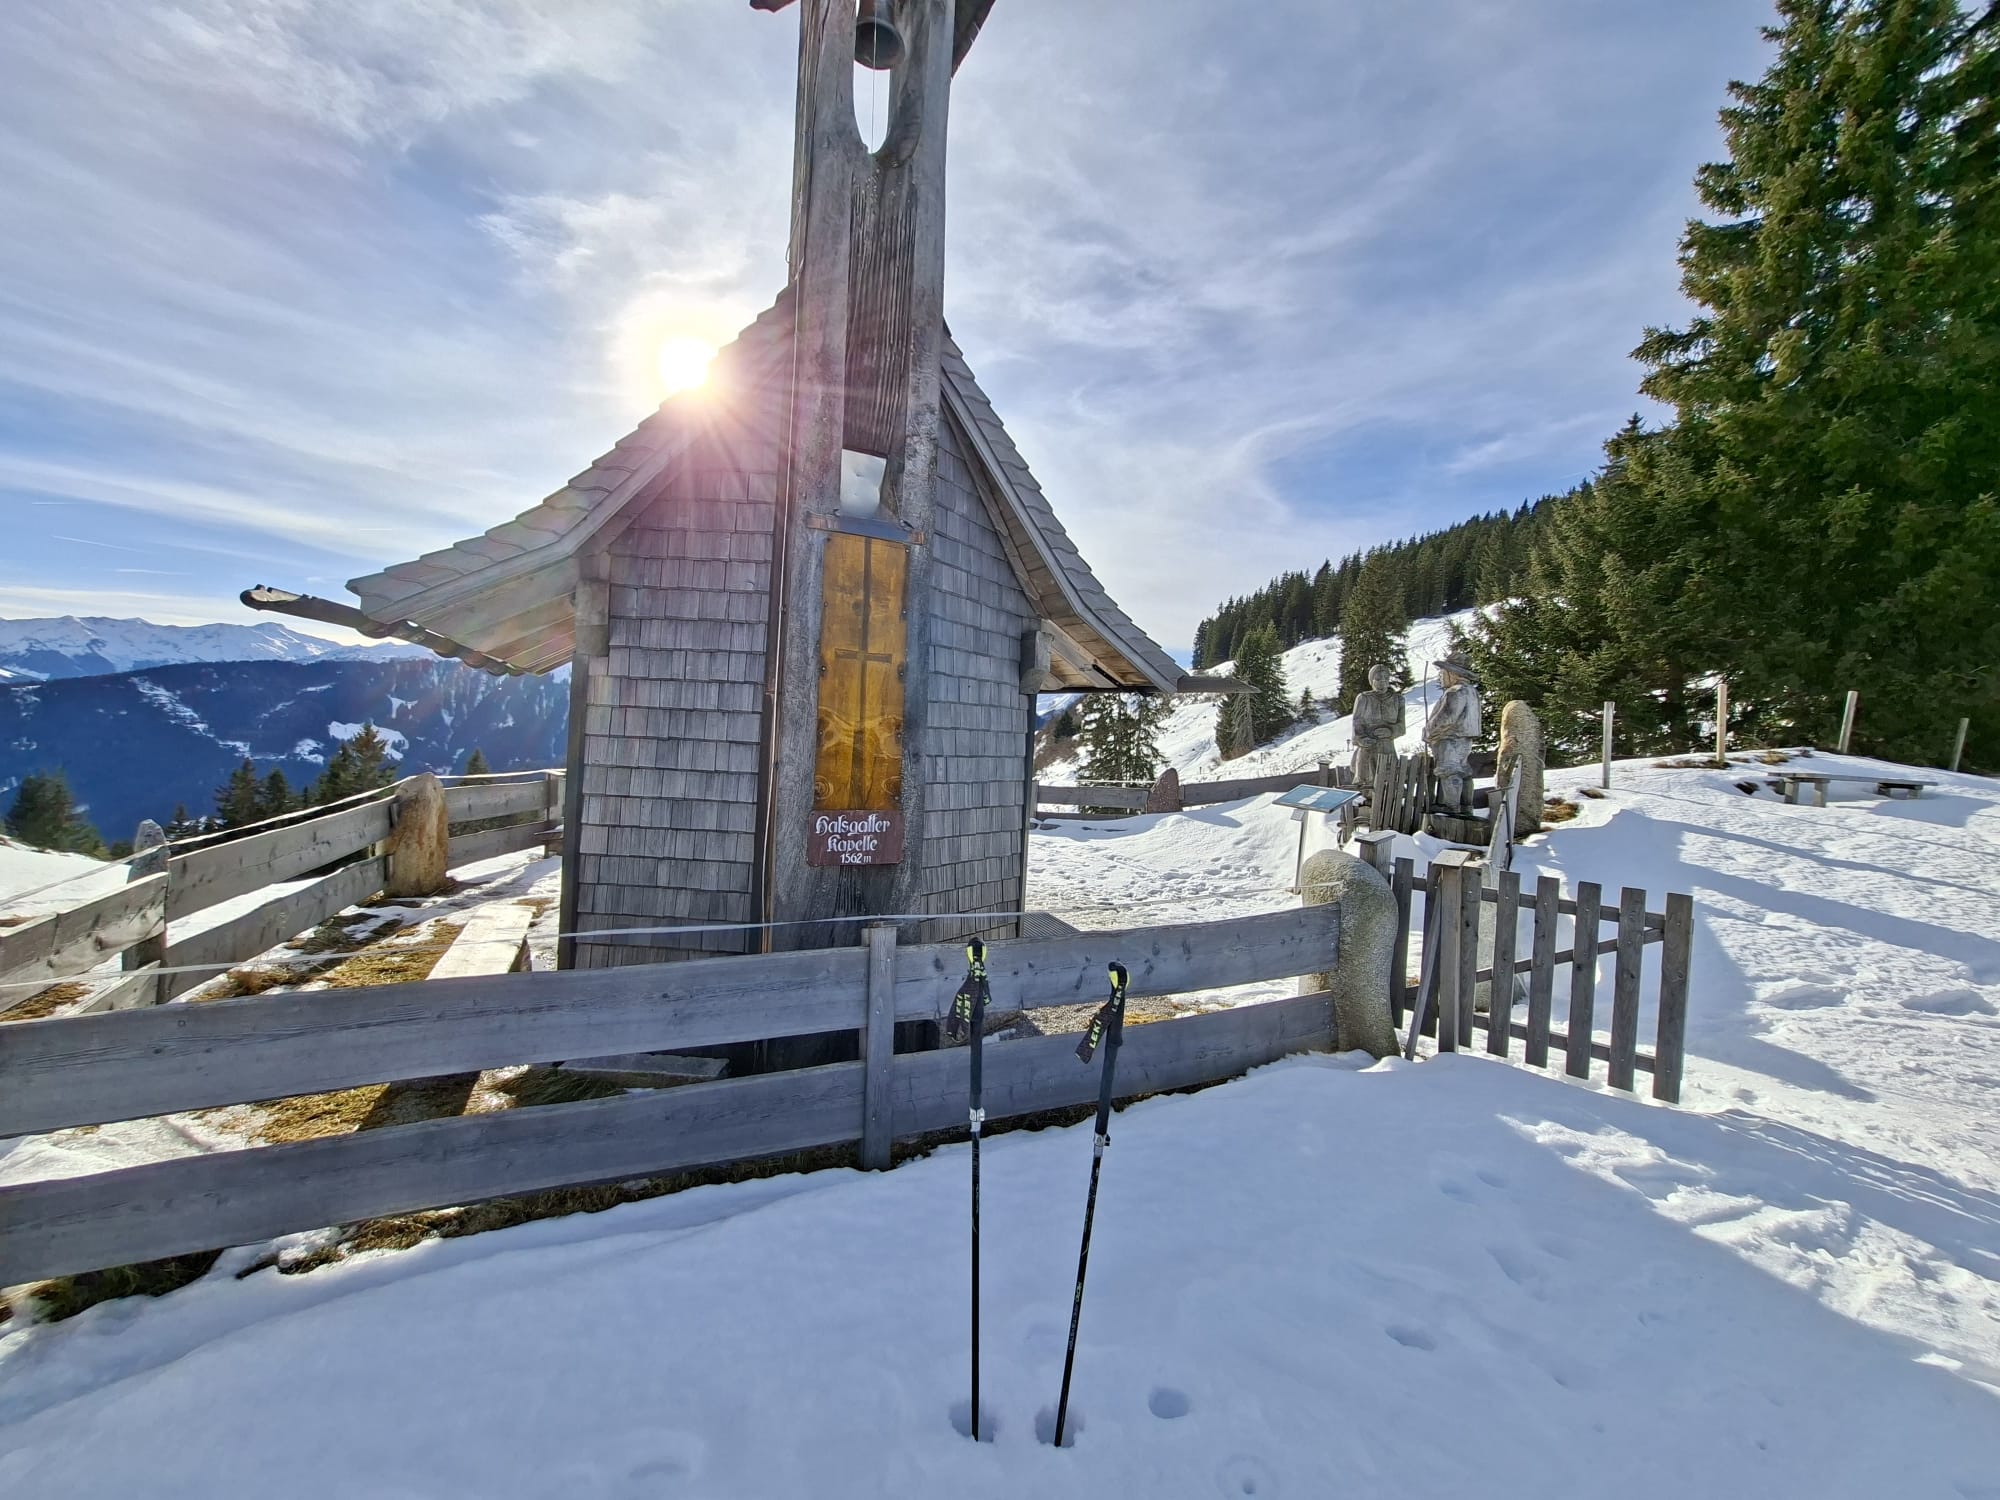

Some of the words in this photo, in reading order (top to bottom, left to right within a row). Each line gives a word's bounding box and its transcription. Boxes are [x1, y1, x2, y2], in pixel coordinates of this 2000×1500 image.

[827, 834, 877, 852] Kapelle
[840, 852, 863, 864] 1562
[863, 855, 872, 863] m
[964, 993, 972, 1024] LEKI
[1089, 1019, 1102, 1049] LEKI
